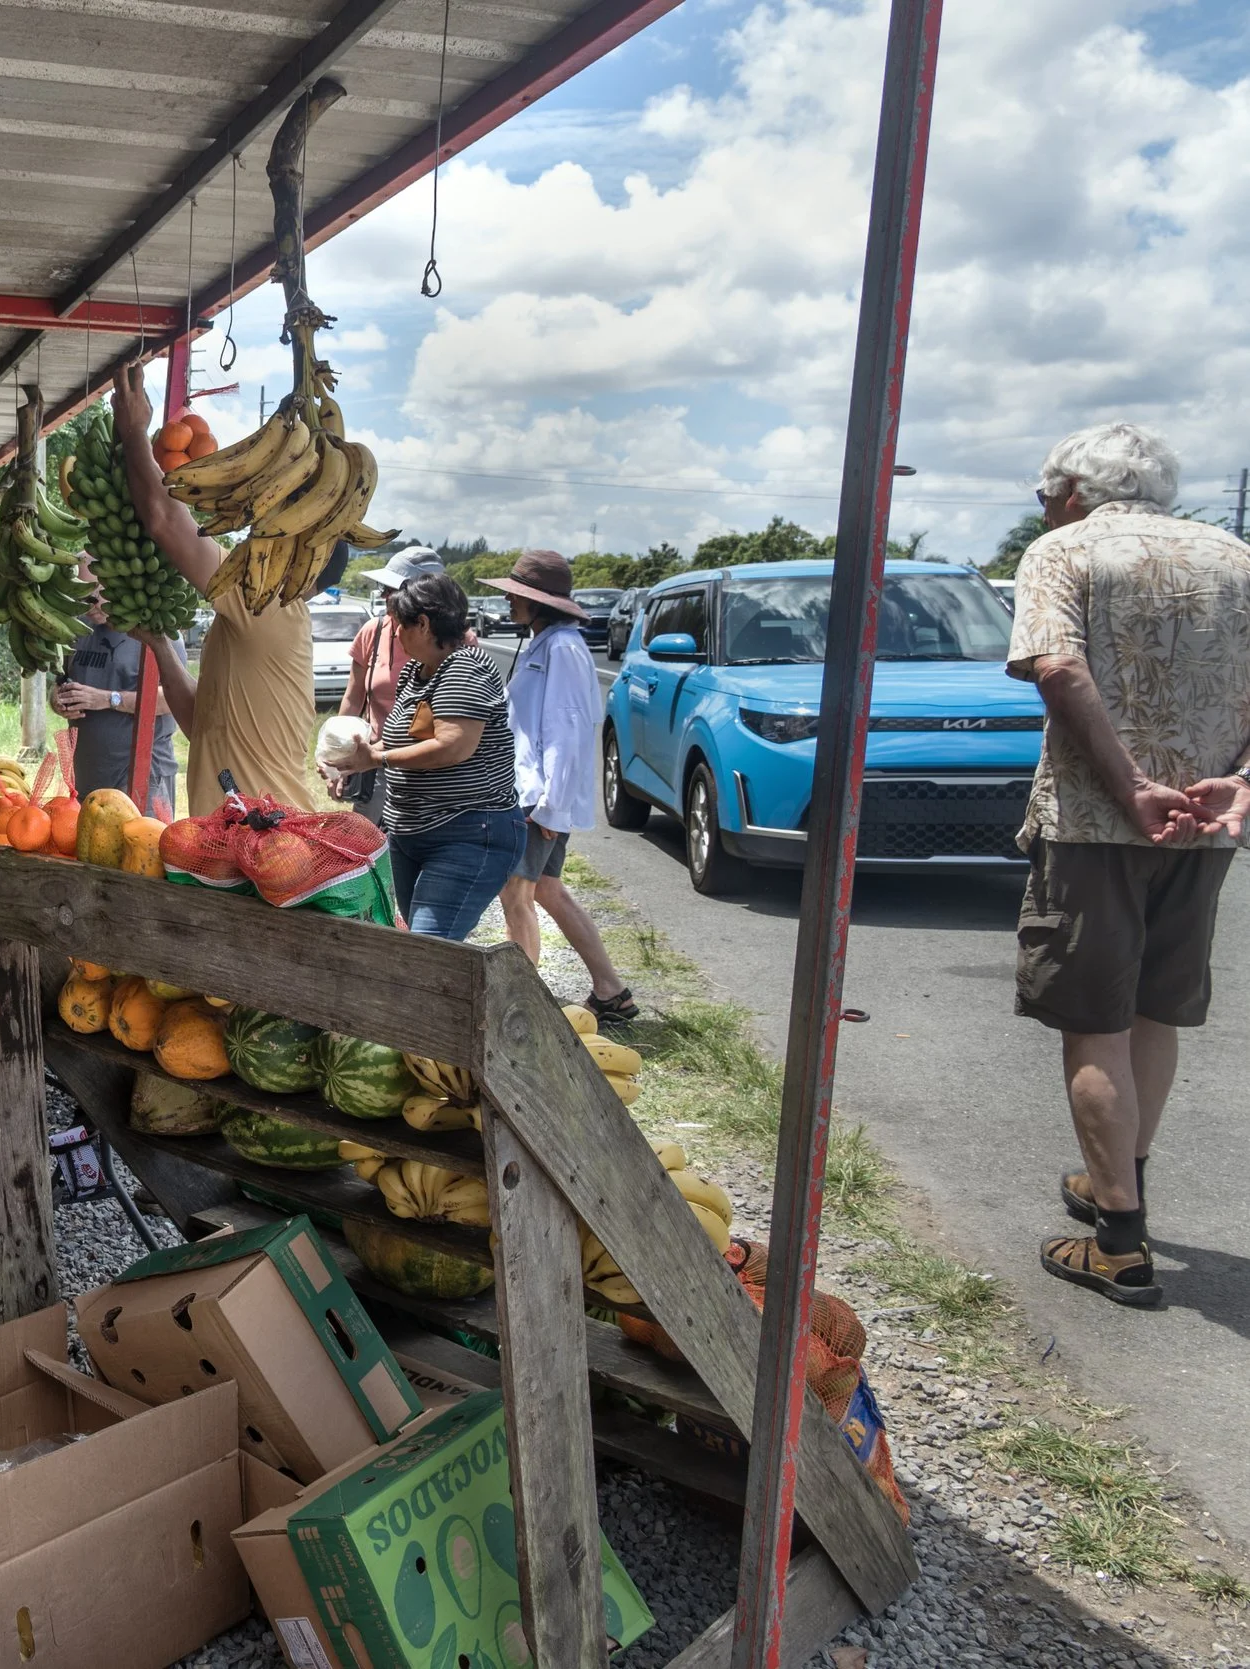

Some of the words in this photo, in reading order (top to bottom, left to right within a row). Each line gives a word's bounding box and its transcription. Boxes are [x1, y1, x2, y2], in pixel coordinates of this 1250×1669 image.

[74, 650, 109, 669] PUMA
[366, 1424, 511, 1556] VOCADOS
[337, 1534, 358, 1569] COUNT
